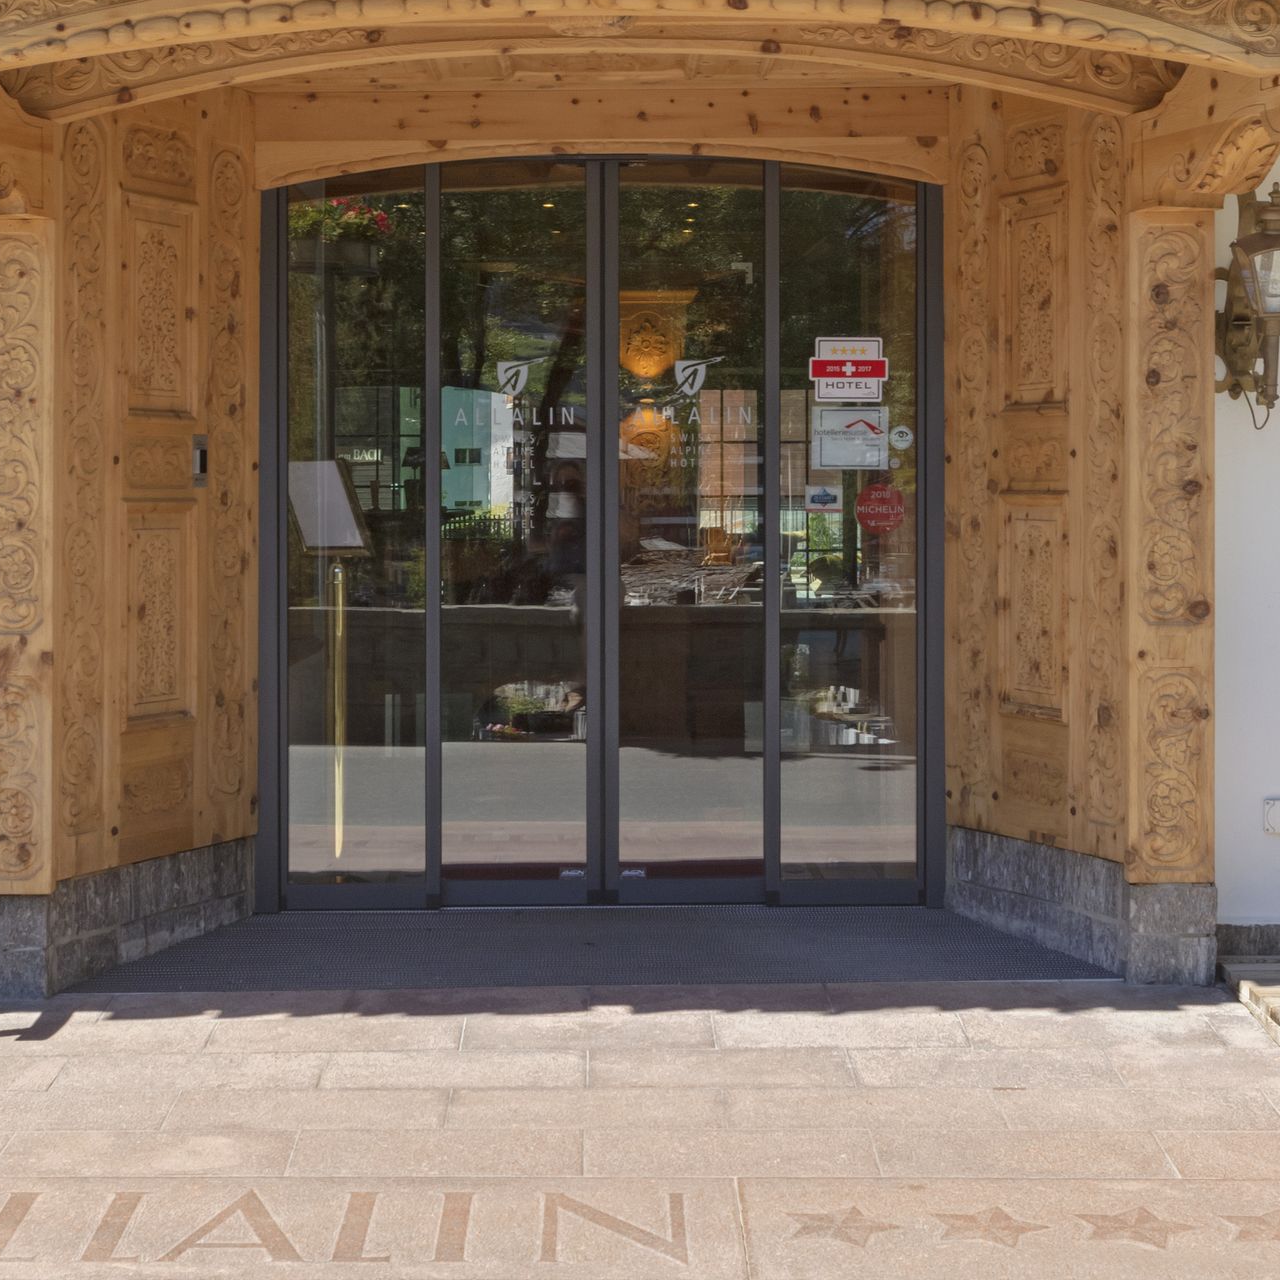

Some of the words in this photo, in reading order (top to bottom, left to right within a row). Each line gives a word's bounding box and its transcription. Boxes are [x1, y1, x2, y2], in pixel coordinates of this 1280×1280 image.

[825, 381, 872, 389] HOTEL
[454, 407, 575, 425] ALLALIN
[632, 406, 752, 425] ALLALIN
[670, 458, 706, 468] HOT
[857, 505, 904, 514] MICHELIN
